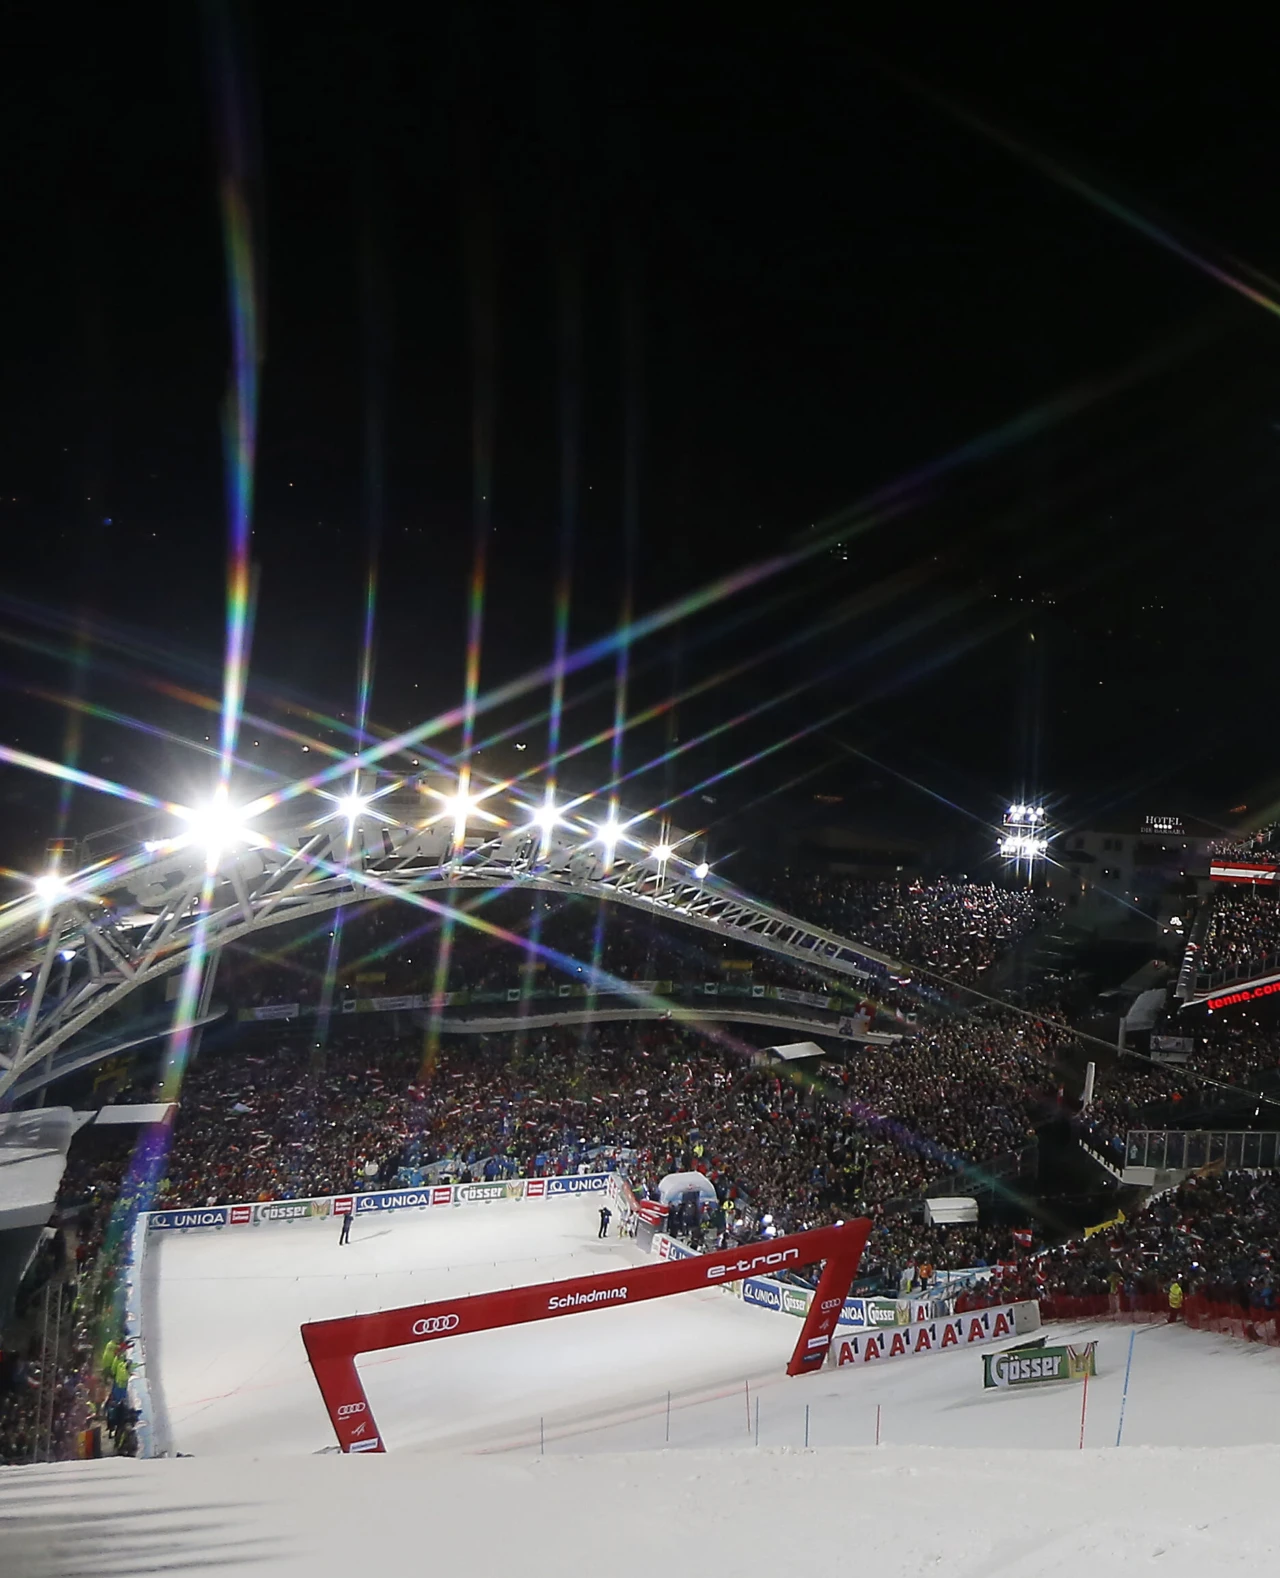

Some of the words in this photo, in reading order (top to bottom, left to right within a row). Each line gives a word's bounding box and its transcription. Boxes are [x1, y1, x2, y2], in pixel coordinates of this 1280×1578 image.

[1145, 815, 1183, 826] HOTEL
[569, 1177, 609, 1192] UNIQA
[382, 1193, 428, 1207] UNIQA
[457, 1185, 503, 1202] Gösser
[173, 1213, 224, 1226] UNIQA
[257, 1204, 306, 1221] Gösser
[707, 1248, 799, 1279] e-tron
[548, 1286, 628, 1310] Schladming
[754, 1288, 780, 1306] UNIQA
[840, 1306, 864, 1321] NIQA
[867, 1302, 895, 1325] Gösser
[838, 1337, 858, 1367] A1
[864, 1332, 884, 1362] A1
[889, 1328, 911, 1357] A1
[914, 1323, 936, 1352] A1
[941, 1318, 963, 1348] A1
[967, 1312, 990, 1343] A1
[992, 1308, 1015, 1338] A1
[990, 1353, 1062, 1387] Gösser
